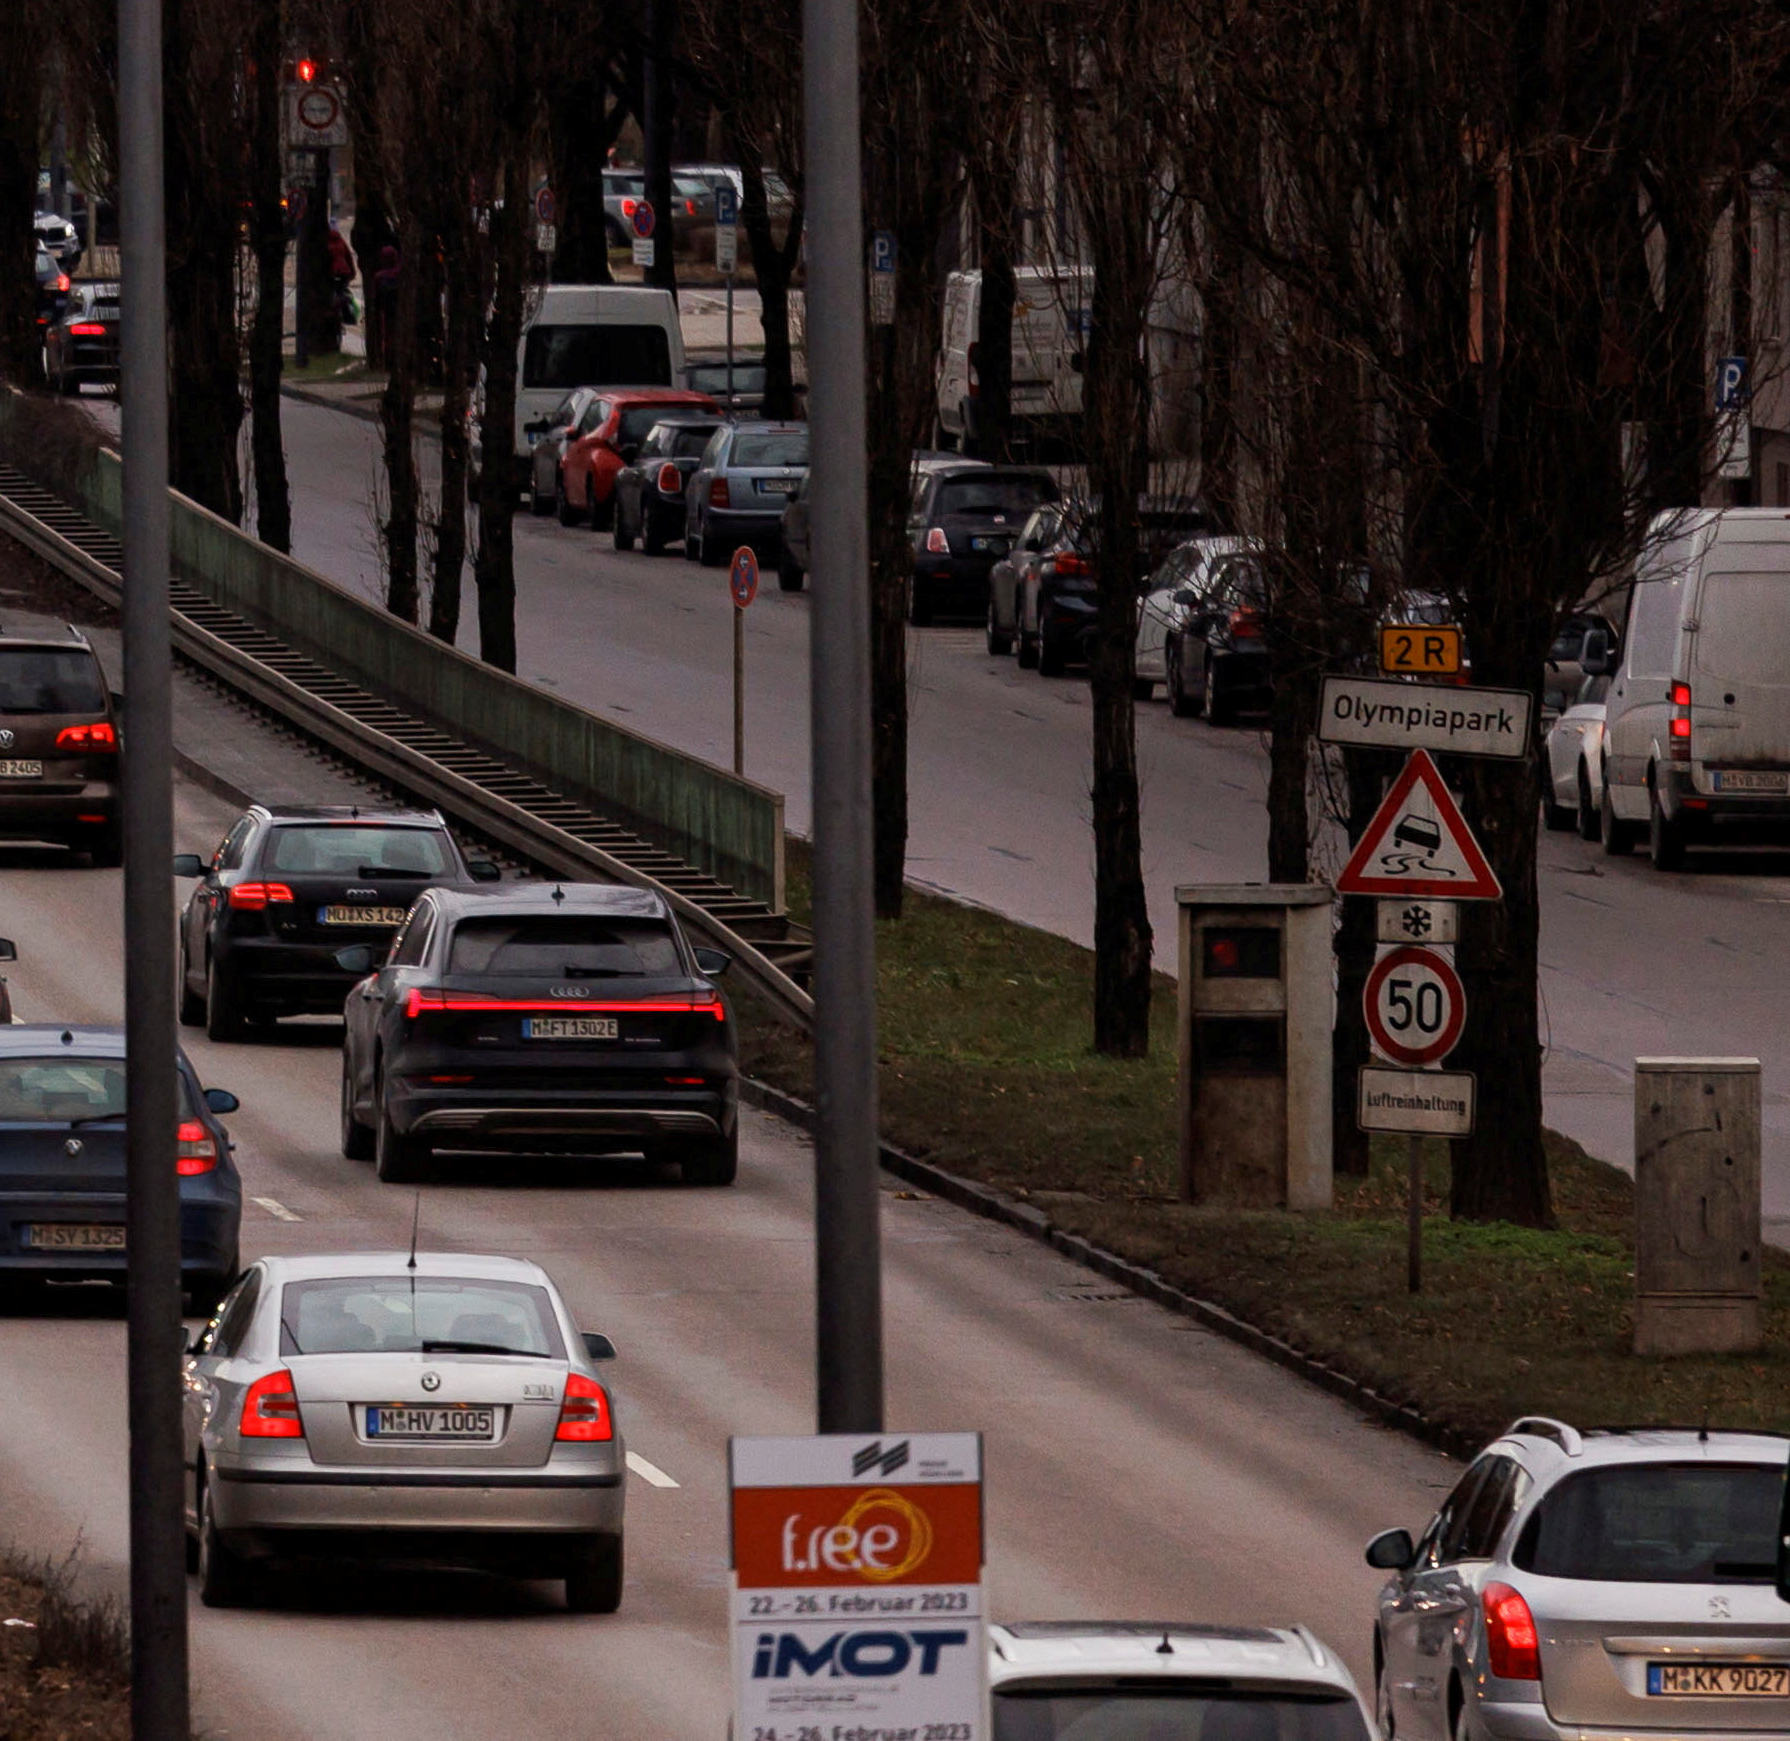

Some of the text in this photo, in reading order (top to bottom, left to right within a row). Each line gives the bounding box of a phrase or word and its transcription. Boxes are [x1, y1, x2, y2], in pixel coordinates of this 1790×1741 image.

[1723, 363, 1741, 402] P
[1394, 636, 1444, 666] 2 R
[1334, 694, 1513, 736] Olympiapark
[356, 908, 374, 922] XS
[377, 908, 403, 922] 142
[1388, 978, 1443, 1033] 50
[531, 1021, 542, 1035] M
[550, 1021, 567, 1036] FT
[1366, 1091, 1466, 1116] Luftreinhaltung
[381, 1411, 490, 1431] M HV 1005
[828, 1594, 914, 1612] Februar
[921, 1592, 968, 1610] 2023
[752, 1630, 968, 1678] iMOT
[1663, 1668, 1787, 1692] M KK 9027
[832, 1724, 919, 1741] Februar
[924, 1723, 972, 1740] 2023
